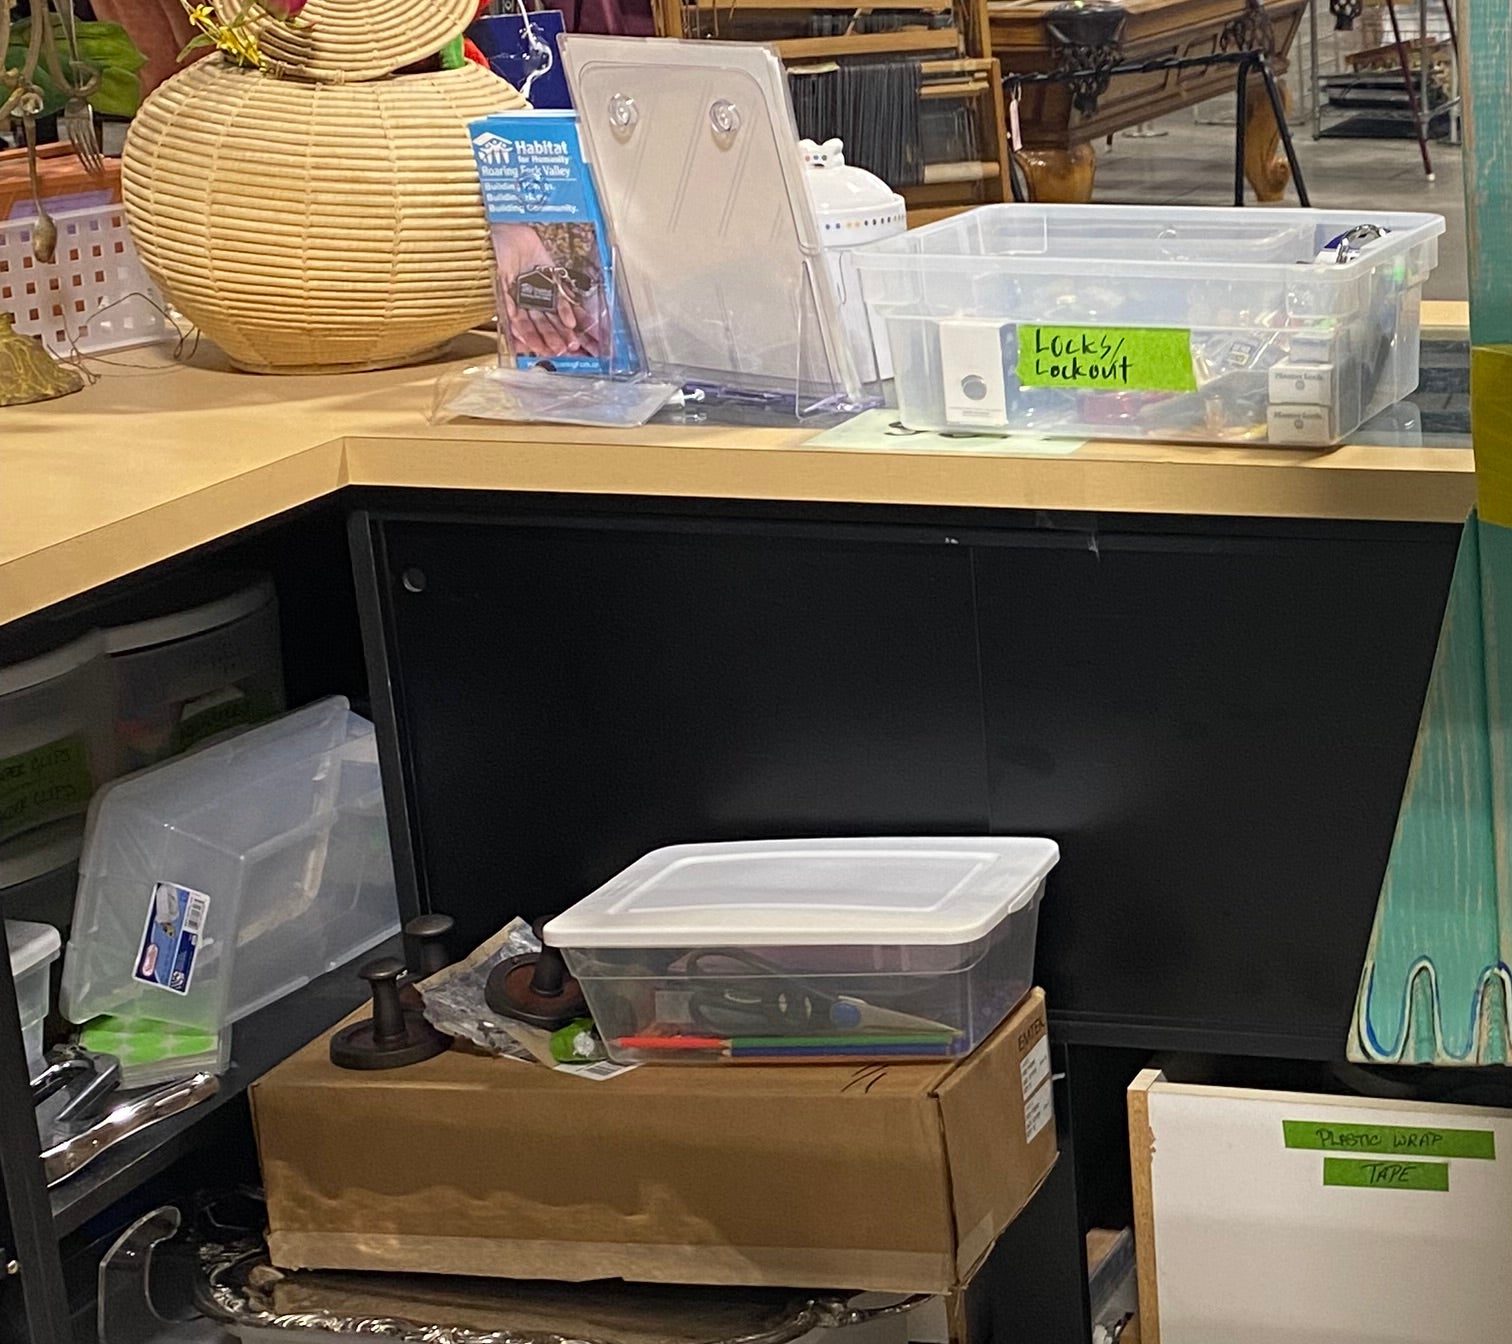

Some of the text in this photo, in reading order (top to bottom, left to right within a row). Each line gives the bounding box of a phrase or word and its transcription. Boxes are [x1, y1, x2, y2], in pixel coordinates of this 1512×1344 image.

[514, 140, 568, 155] Habitat
[481, 166, 518, 178] Roaring
[542, 165, 570, 178] Valley
[488, 204, 525, 214] Building
[1035, 356, 1134, 384] Lockout
[1315, 1129, 1443, 1148] PLASTIC WRAP
[1361, 1163, 1417, 1184] TAPE
